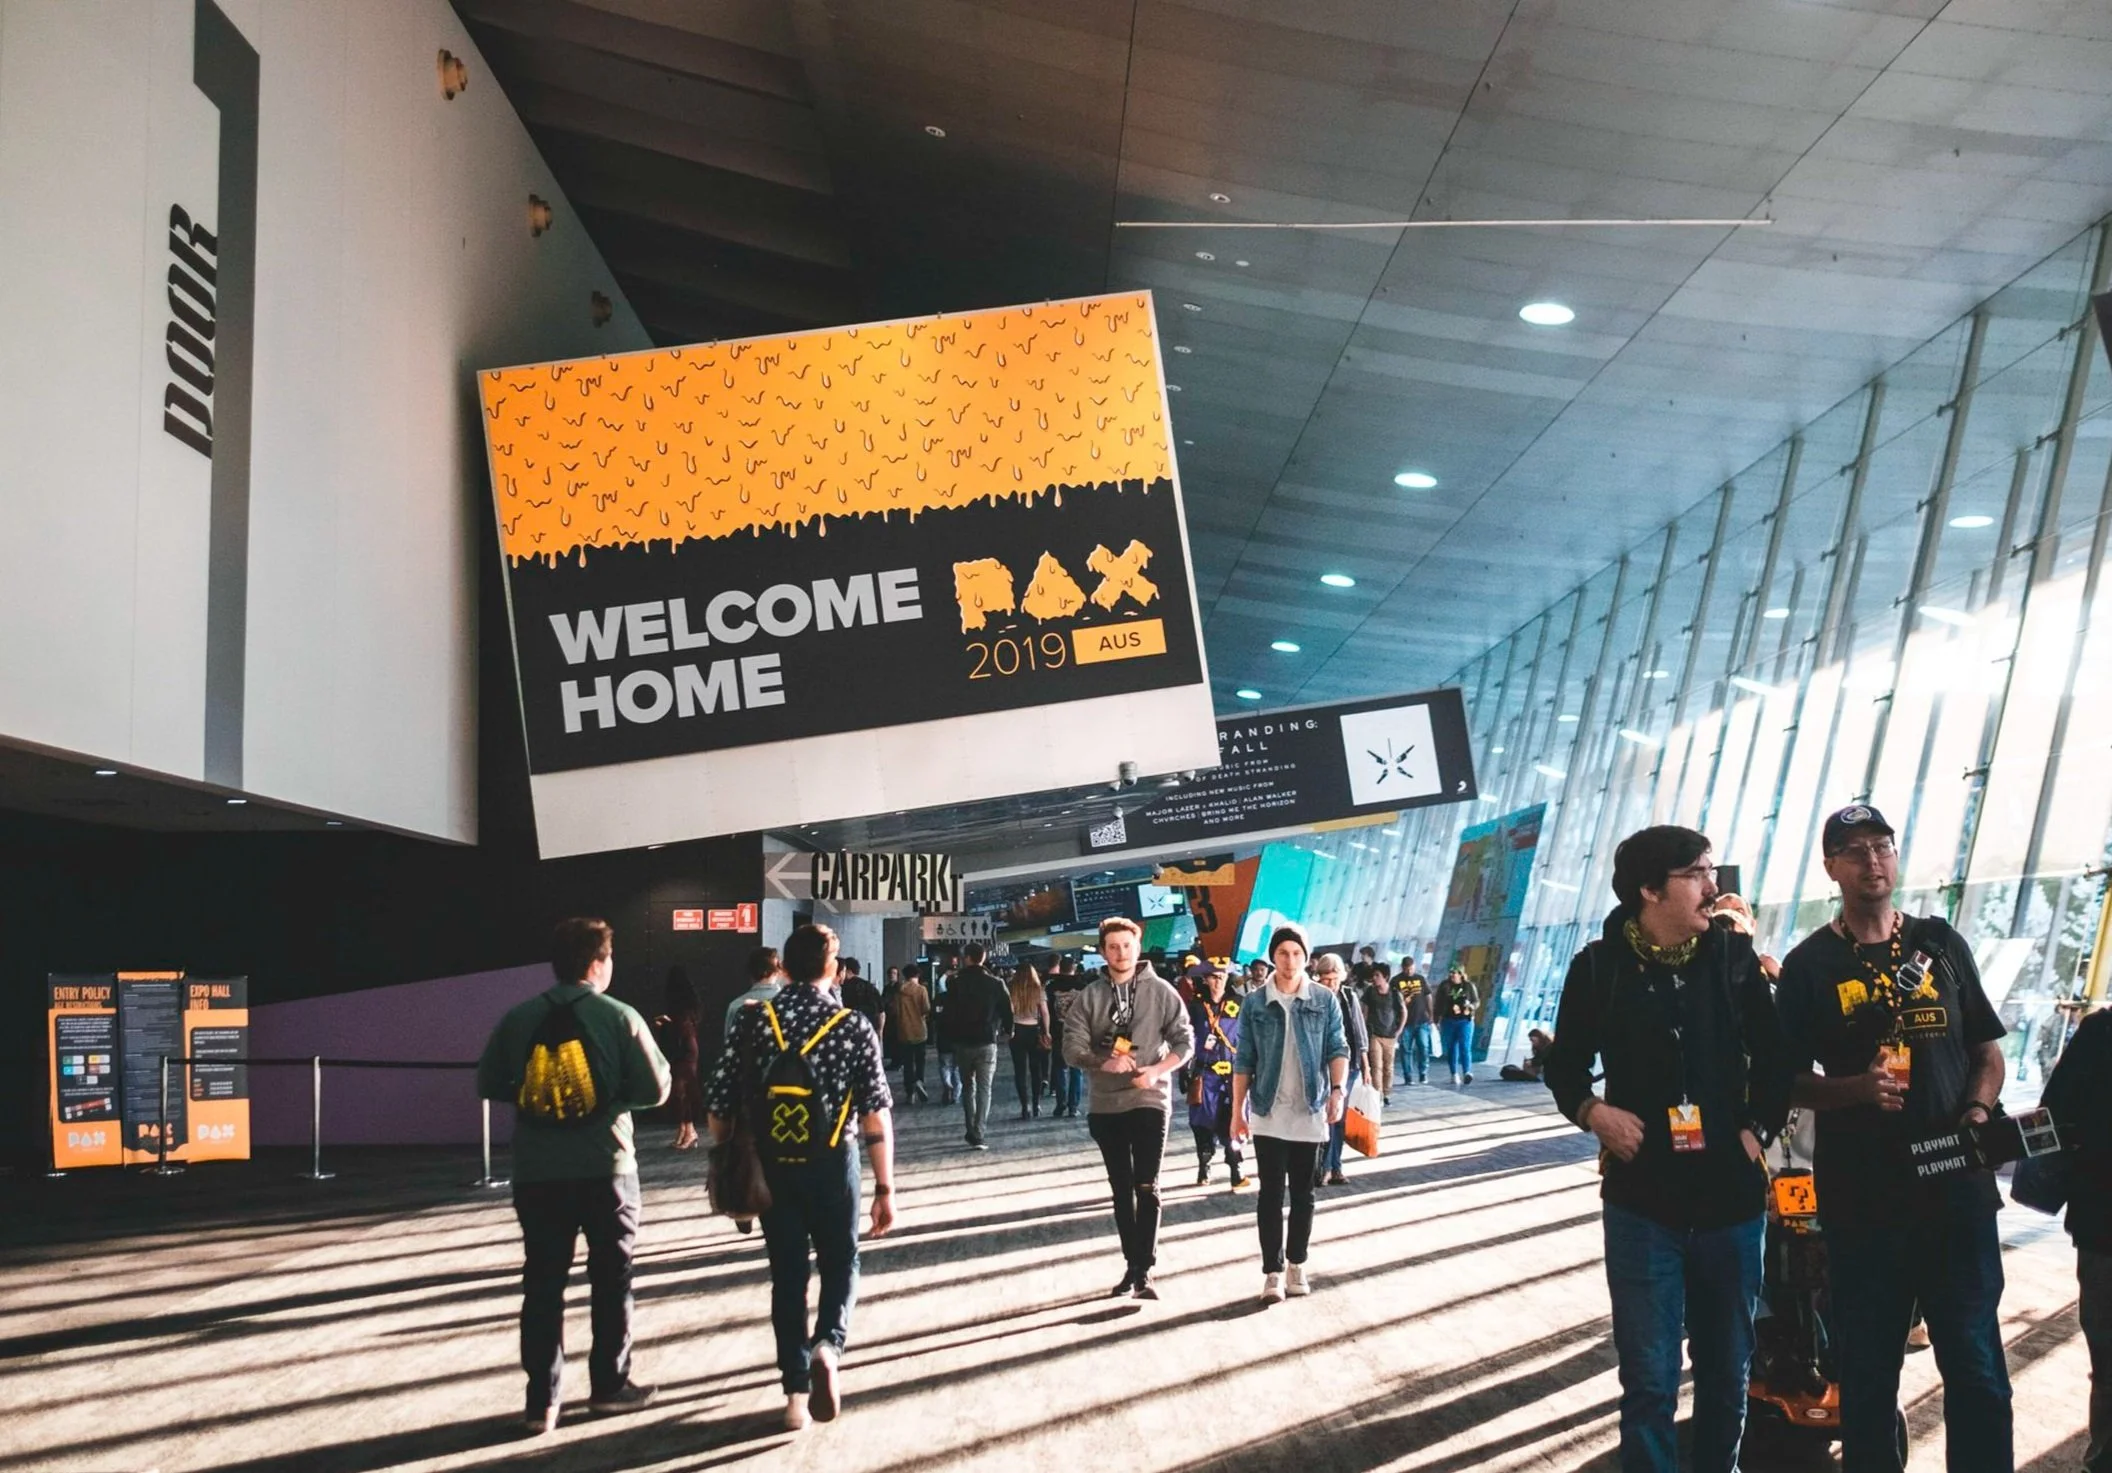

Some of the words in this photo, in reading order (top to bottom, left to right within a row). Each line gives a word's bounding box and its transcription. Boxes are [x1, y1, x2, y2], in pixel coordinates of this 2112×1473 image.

[164, 204, 218, 458] DOOR
[953, 539, 1160, 636] PAX
[549, 567, 923, 665] WELCOME
[1099, 629, 1142, 652] AUS
[966, 632, 1066, 679] 2019
[561, 653, 786, 733] HOME
[1219, 719, 1318, 741] RANDING:
[1219, 742, 1268, 755] FALL
[1211, 771, 1240, 780] DEATH
[1245, 763, 1297, 775] STRANDING
[1218, 761, 1240, 770] USIC
[1244, 759, 1269, 767] FROM
[1165, 790, 1207, 801] INCLUDING
[1209, 787, 1225, 795] NEW
[1227, 784, 1251, 793] MUSIC
[1253, 781, 1274, 789] FROM
[1146, 808, 1173, 817] MAJOR
[1175, 804, 1200, 813] LAZER
[1208, 799, 1238, 808] KHALID
[1243, 794, 1264, 803] ALAN
[1266, 790, 1297, 799] WALKER
[1201, 809, 1226, 817] BRING
[1228, 806, 1240, 814] ME
[1242, 803, 1258, 811] THE
[1260, 799, 1296, 809] HORIZON
[1203, 817, 1220, 825] AND
[1222, 813, 1245, 822] MORE
[811, 852, 950, 901] CARPARK
[54, 986, 80, 1000] ENTRY
[82, 986, 111, 1000] POLICY
[190, 984, 210, 998] EXPO
[211, 984, 231, 998] HALL
[1914, 1013, 1937, 1023] AUS
[1911, 1134, 1960, 1155] PLAYMAT
[1917, 1156, 1967, 1177] PLAYMAT
